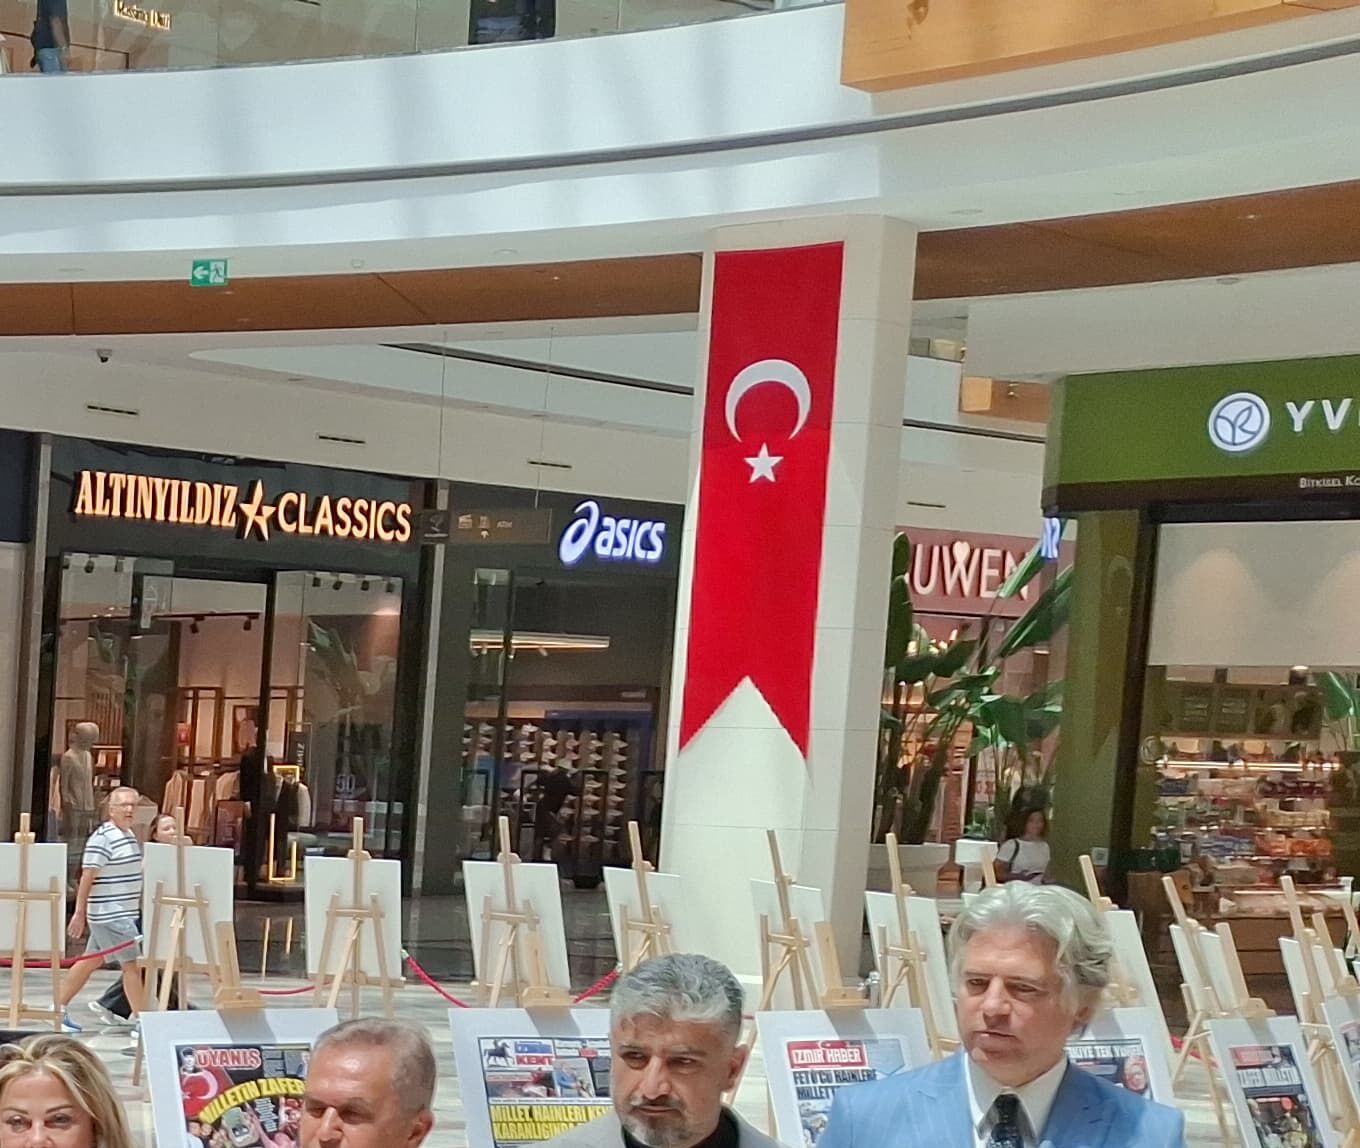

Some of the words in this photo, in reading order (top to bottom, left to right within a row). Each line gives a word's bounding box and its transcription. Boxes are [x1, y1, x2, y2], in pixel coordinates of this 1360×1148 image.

[1286, 398, 1360, 433] YV
[74, 470, 240, 529] ALTINYILDIZ
[276, 492, 413, 542] CLASSICS
